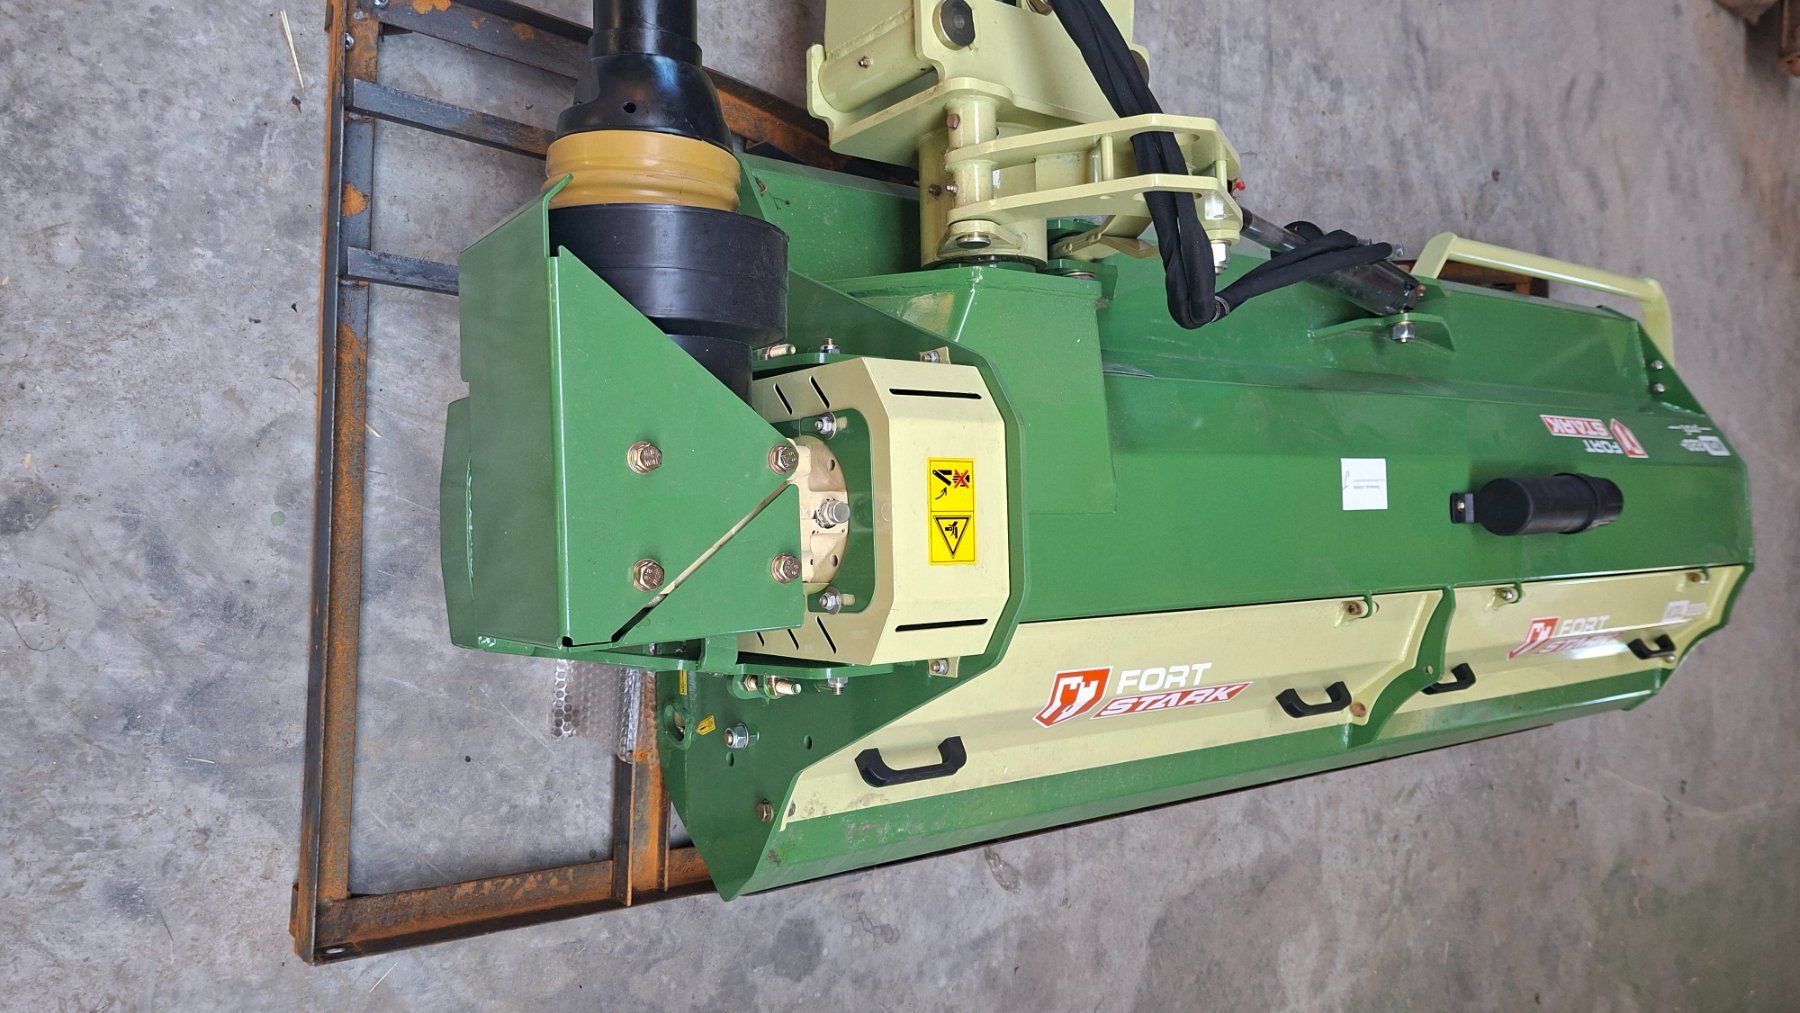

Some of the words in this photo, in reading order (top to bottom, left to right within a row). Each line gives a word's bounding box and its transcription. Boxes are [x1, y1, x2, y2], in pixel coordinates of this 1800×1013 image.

[1543, 417, 1609, 436] STARK
[1582, 440, 1624, 454] FORT
[1560, 615, 1611, 635] FORT
[1116, 662, 1212, 695] FORT
[1100, 685, 1243, 716] STARK
